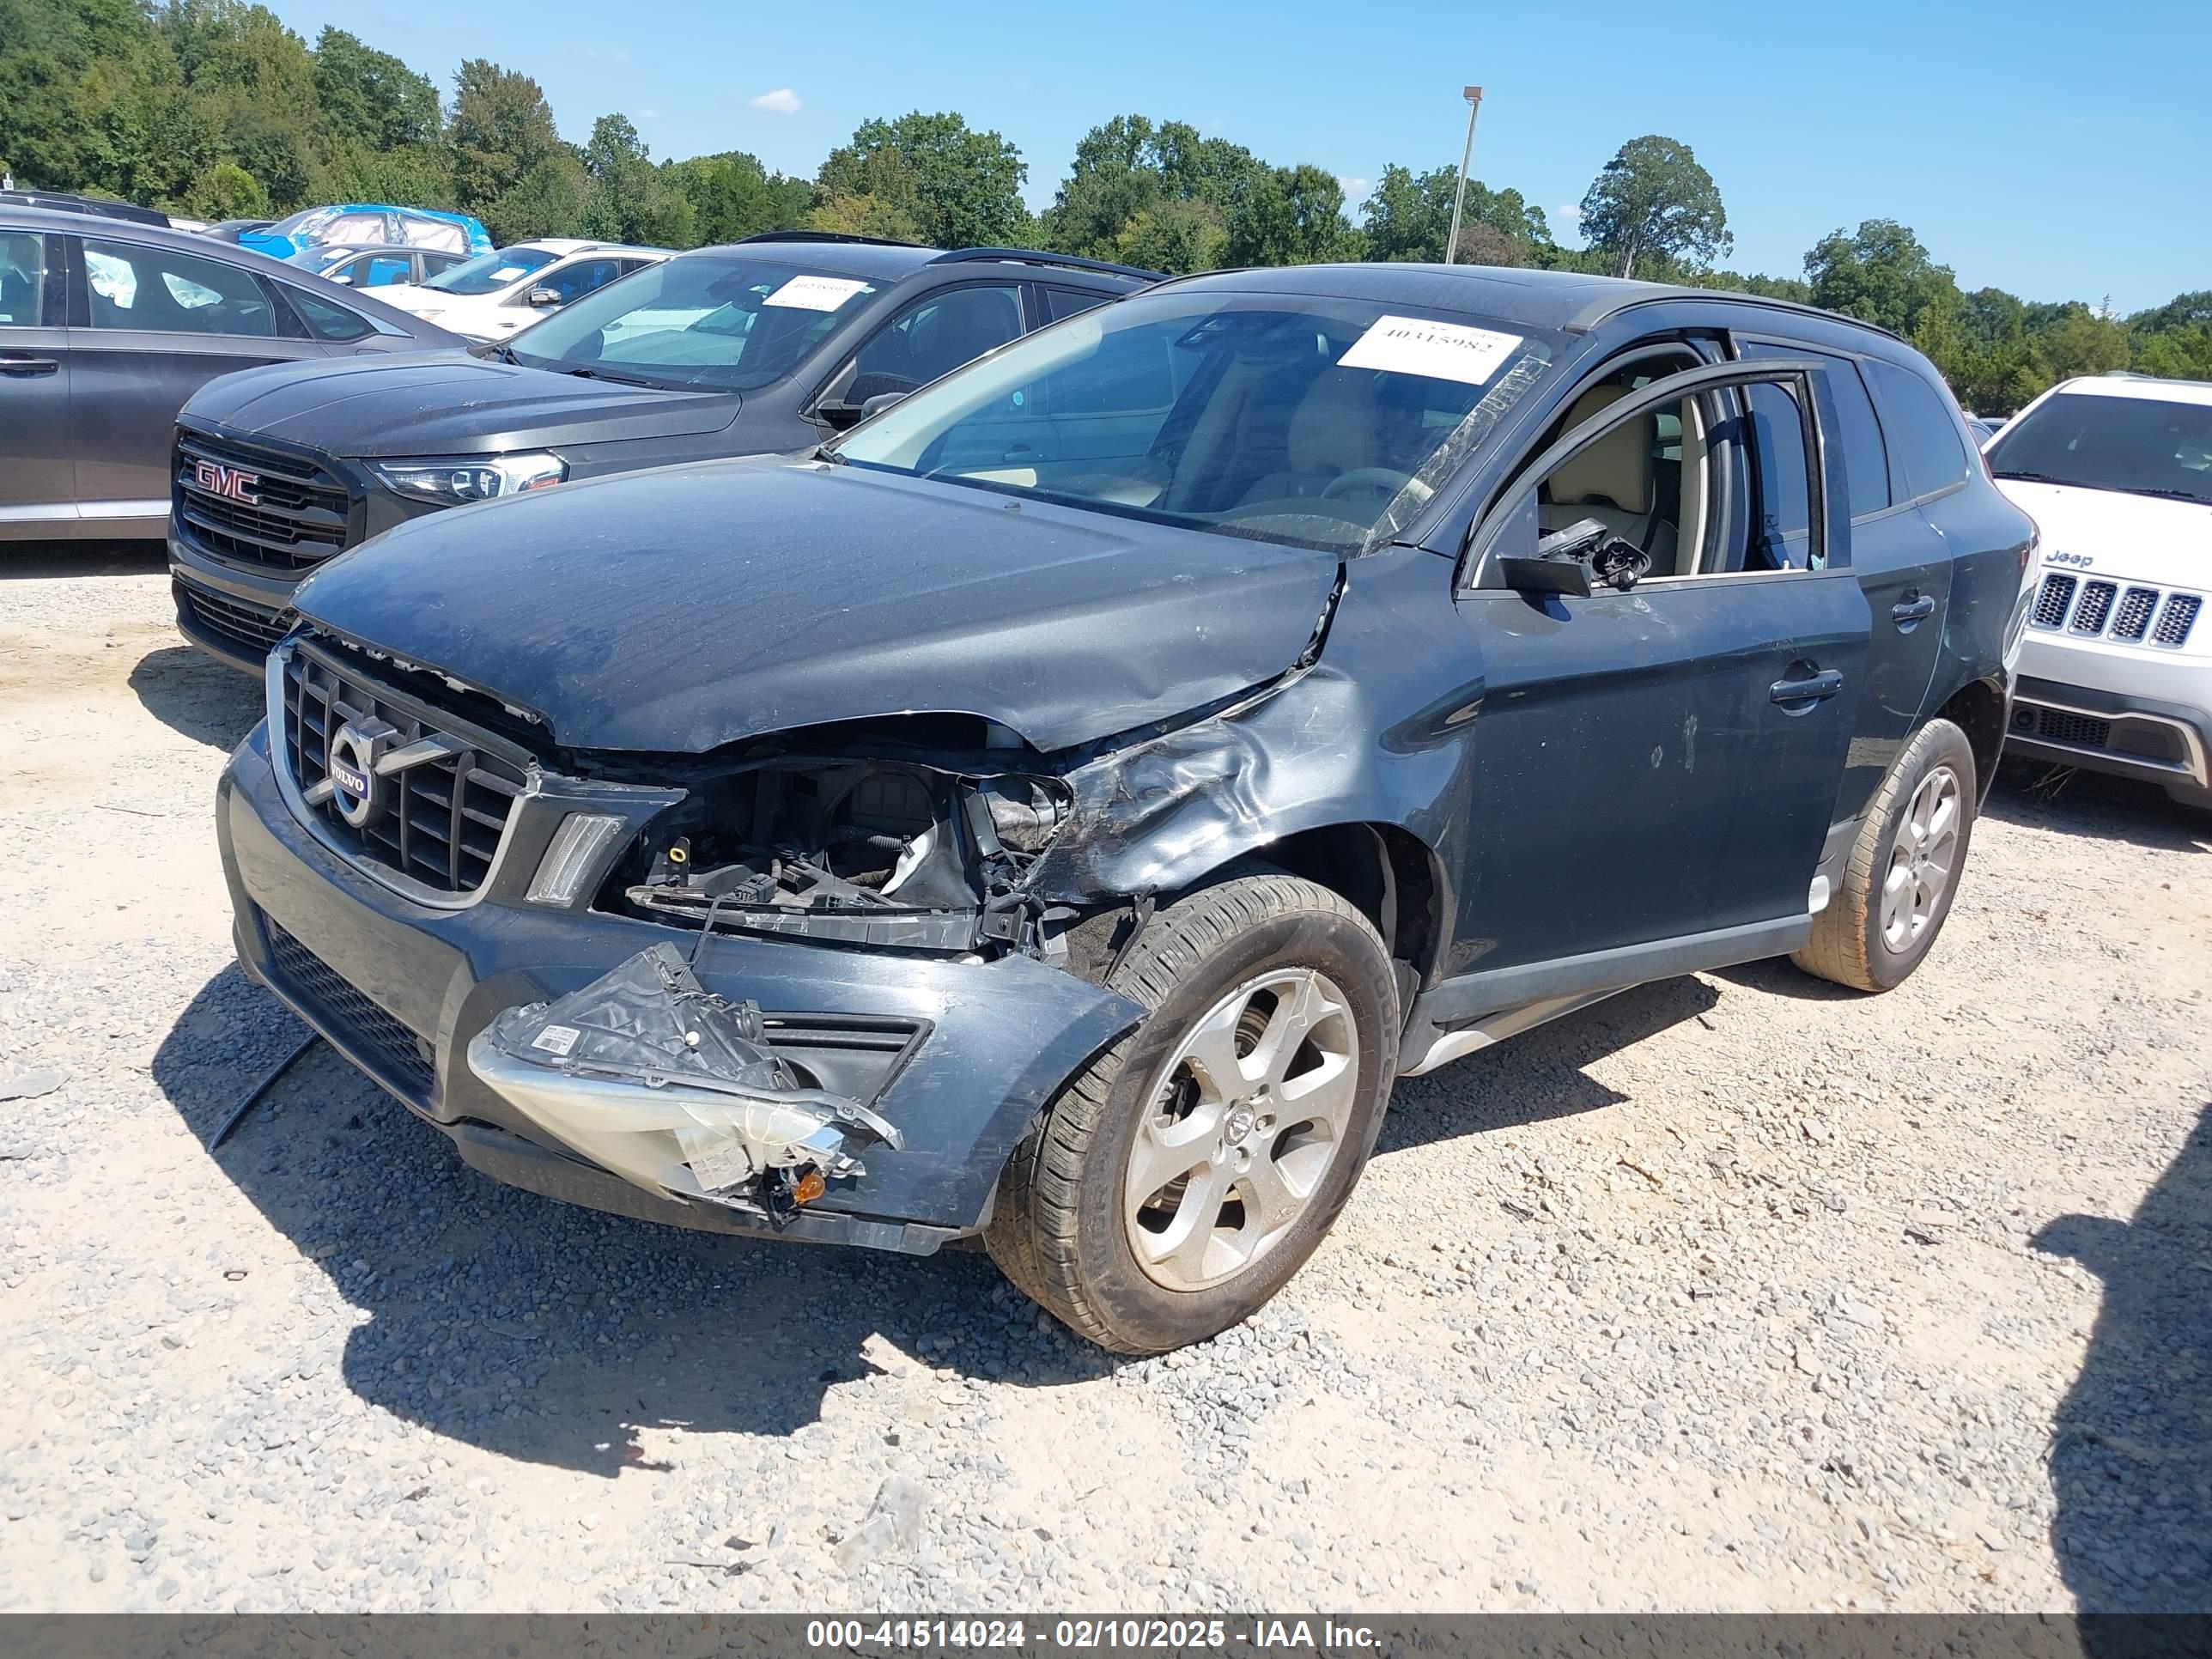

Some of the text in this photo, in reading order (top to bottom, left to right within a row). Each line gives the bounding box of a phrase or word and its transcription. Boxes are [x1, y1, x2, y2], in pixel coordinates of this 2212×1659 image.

[196, 459, 259, 506] GMC
[2045, 550, 2094, 568] Jeep
[331, 762, 364, 792] VOLVO
